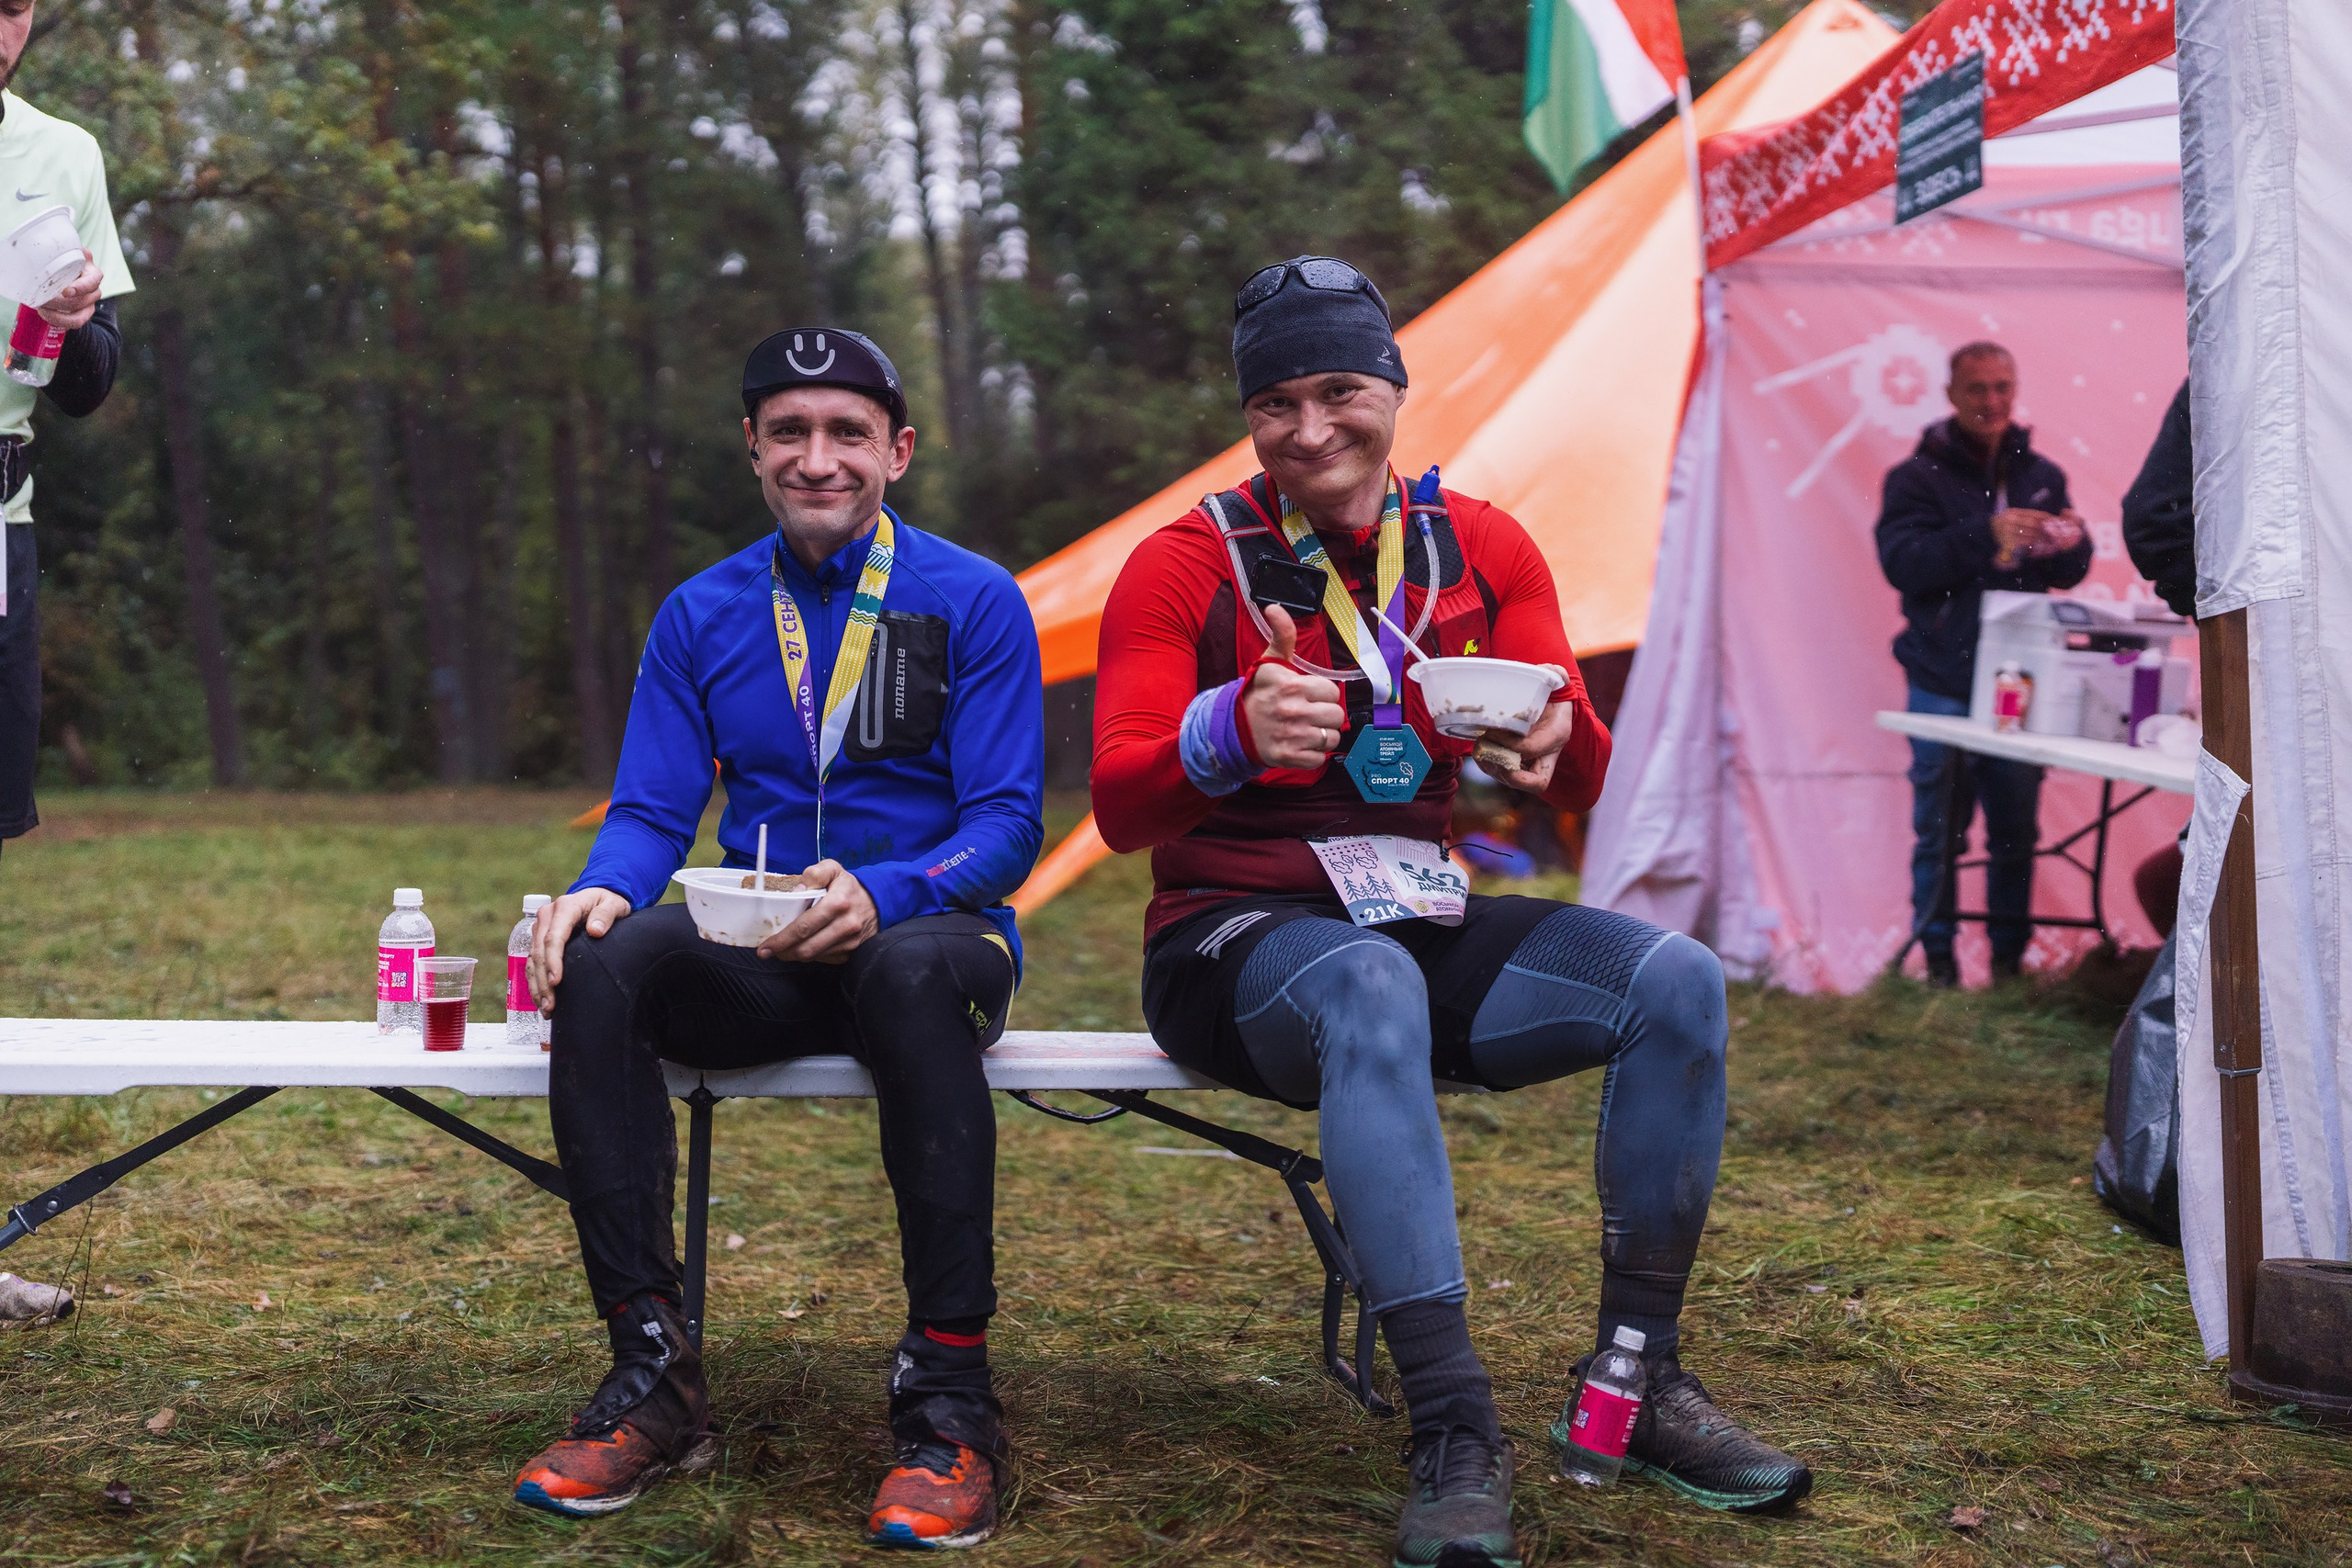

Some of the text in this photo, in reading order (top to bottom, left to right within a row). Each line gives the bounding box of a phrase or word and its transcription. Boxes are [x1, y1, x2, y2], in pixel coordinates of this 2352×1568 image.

[786, 639, 802, 660] 27
[895, 648, 906, 720] noname
[799, 685, 810, 706] 40
[1327, 834, 1351, 842] ПОРТ
[1398, 861, 1467, 893] 562
[1418, 881, 1467, 899] ДМИТРИ
[1363, 903, 1404, 922] 21K
